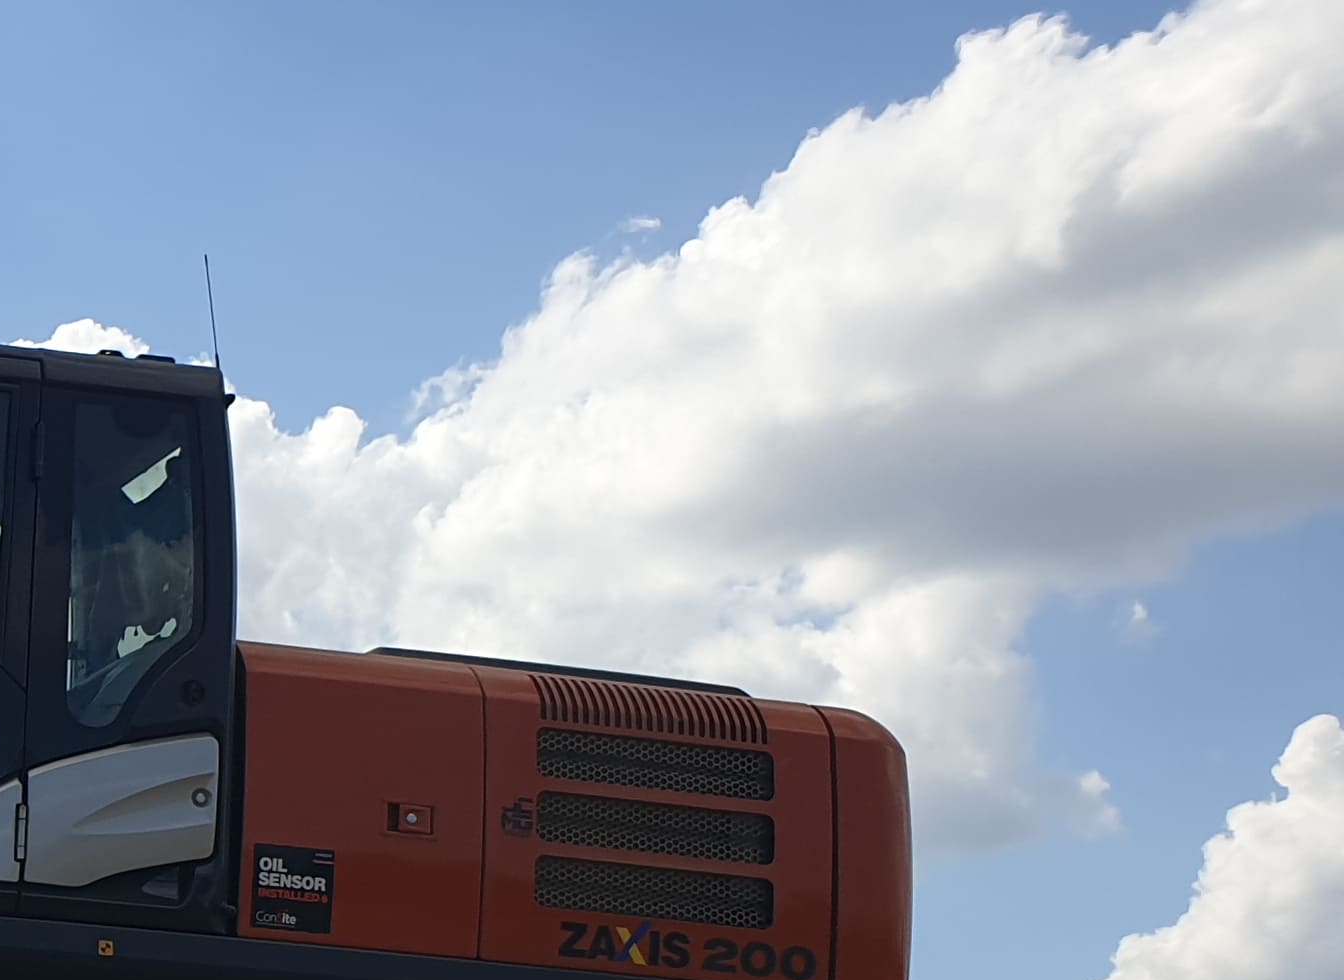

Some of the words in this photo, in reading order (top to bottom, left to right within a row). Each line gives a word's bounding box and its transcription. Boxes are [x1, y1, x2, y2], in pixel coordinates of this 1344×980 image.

[259, 857, 288, 873] OIL
[258, 872, 326, 891] SENSOR
[558, 920, 690, 969] ZAXIS
